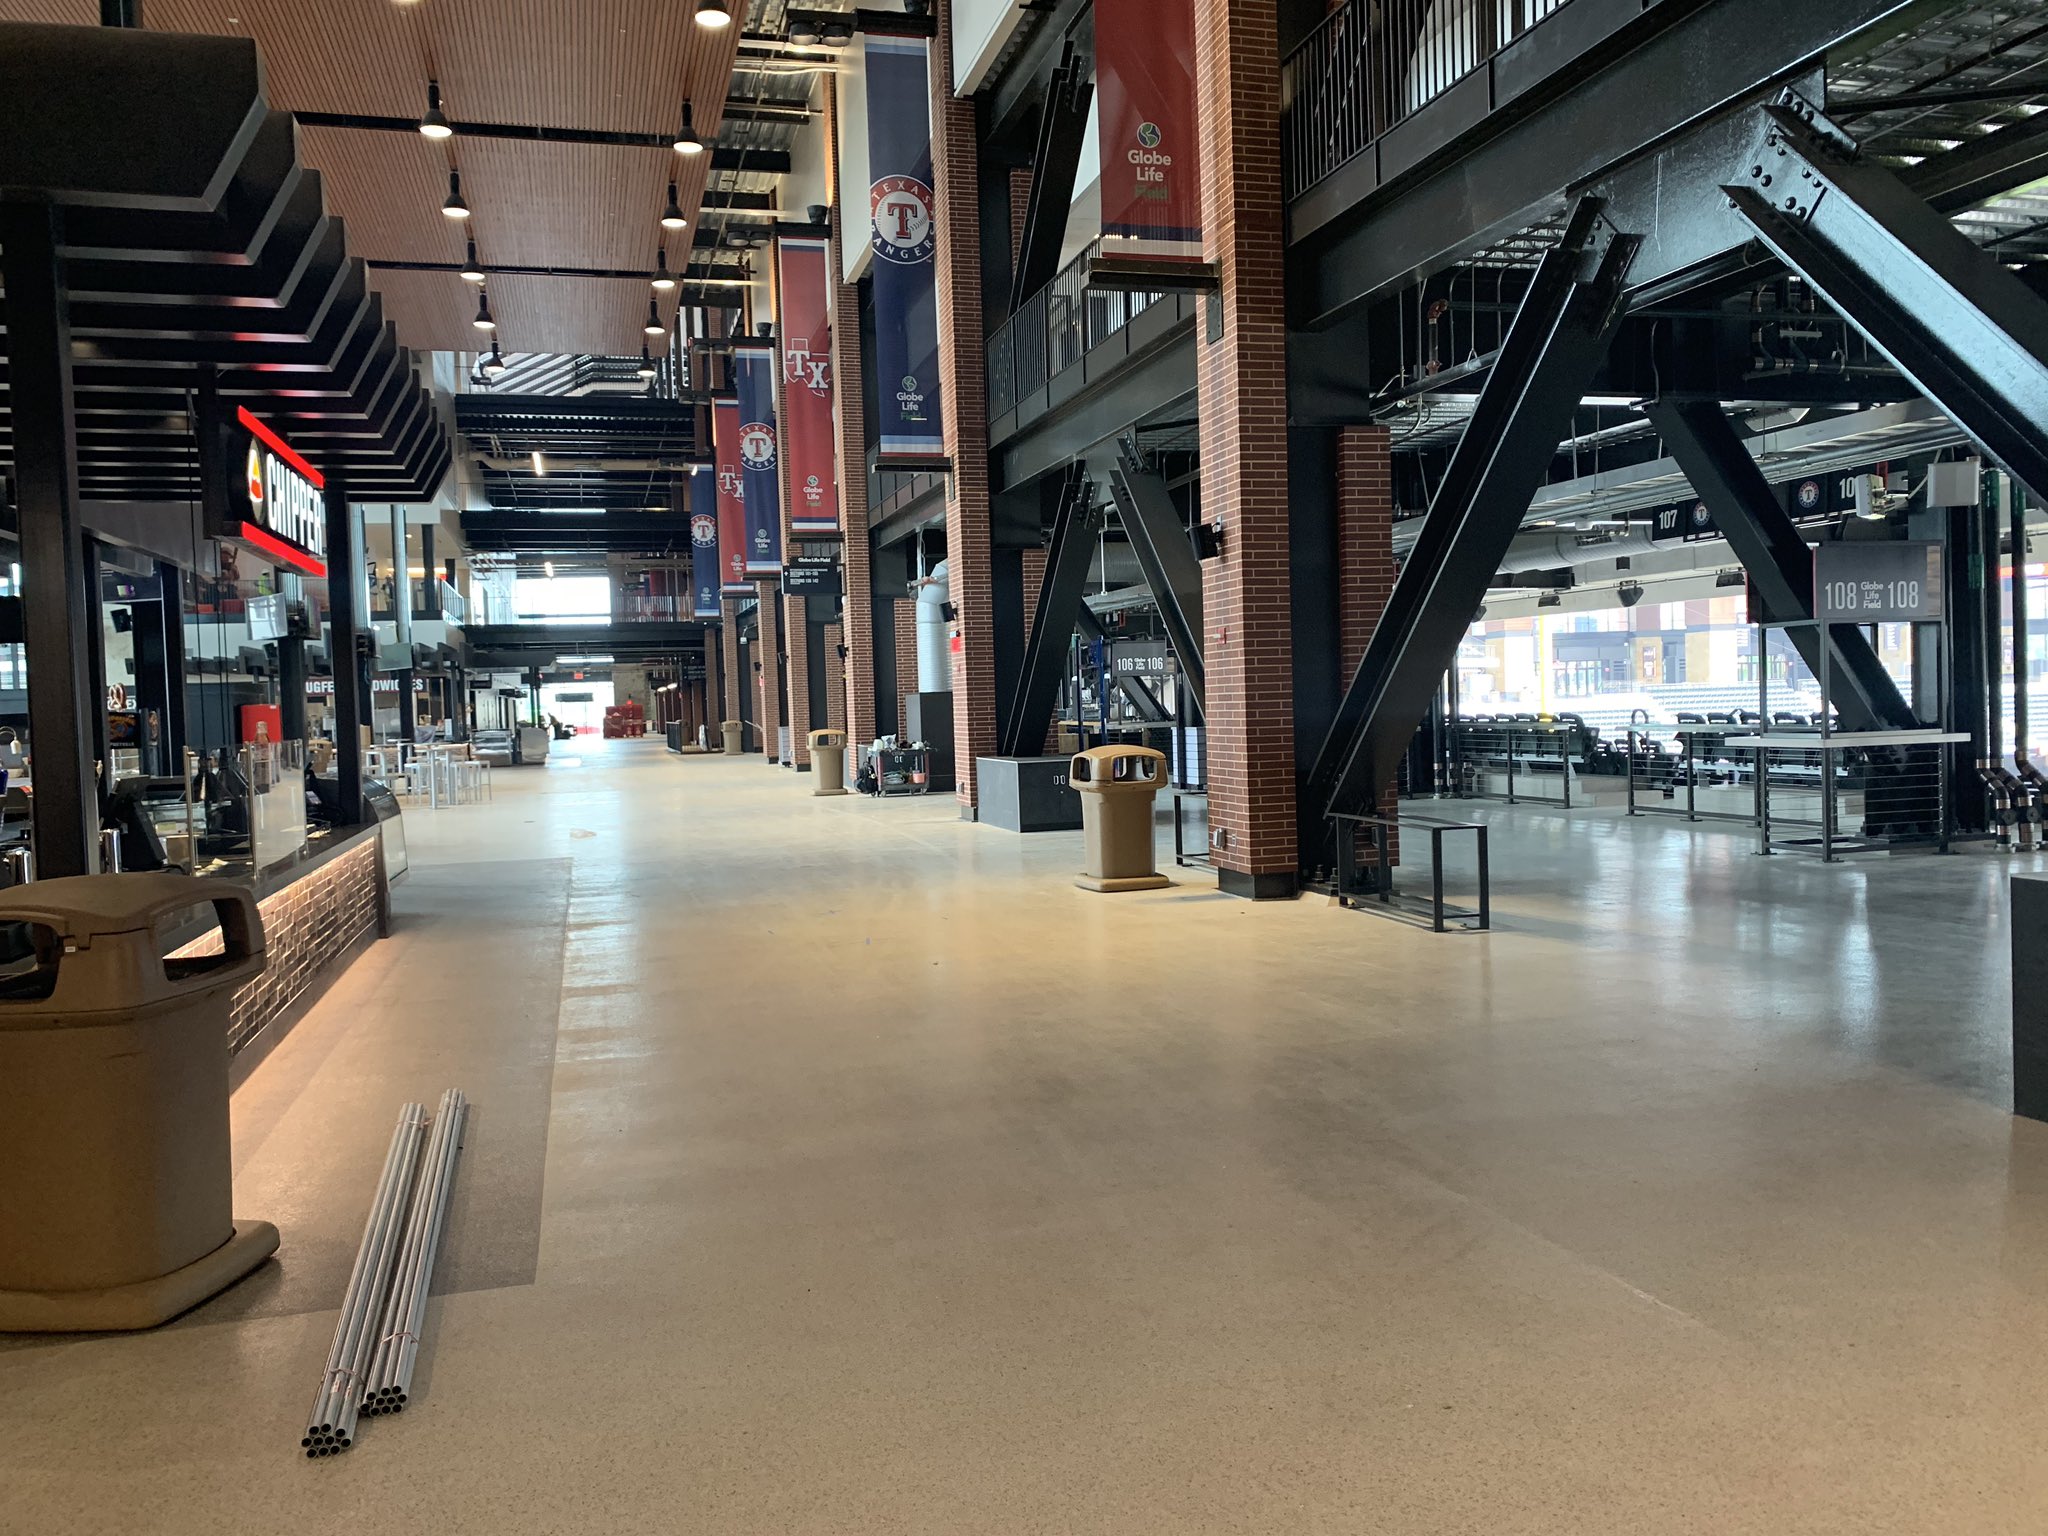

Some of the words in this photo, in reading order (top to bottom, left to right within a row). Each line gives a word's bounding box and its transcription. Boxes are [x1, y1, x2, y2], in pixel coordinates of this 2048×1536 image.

[1128, 149, 1172, 166] Globe
[1136, 166, 1164, 182] Life
[871, 180, 931, 203] TEXAS
[887, 202, 918, 239] T
[896, 391, 924, 402] Globe
[901, 401, 919, 411] Life
[740, 425, 775, 438] TEXAS
[749, 437, 767, 458] T
[803, 486, 824, 494] Globe
[1839, 476, 1856, 499] 10
[266, 452, 323, 556] CHIPPER
[1659, 509, 1678, 530] 107
[1860, 581, 1884, 591] Globe
[1887, 580, 1919, 608] 108
[1825, 581, 1857, 610] 108
[1865, 591, 1880, 600] Life
[1863, 600, 1882, 609] Field
[1117, 657, 1134, 671] 106
[1147, 656, 1164, 670] 106
